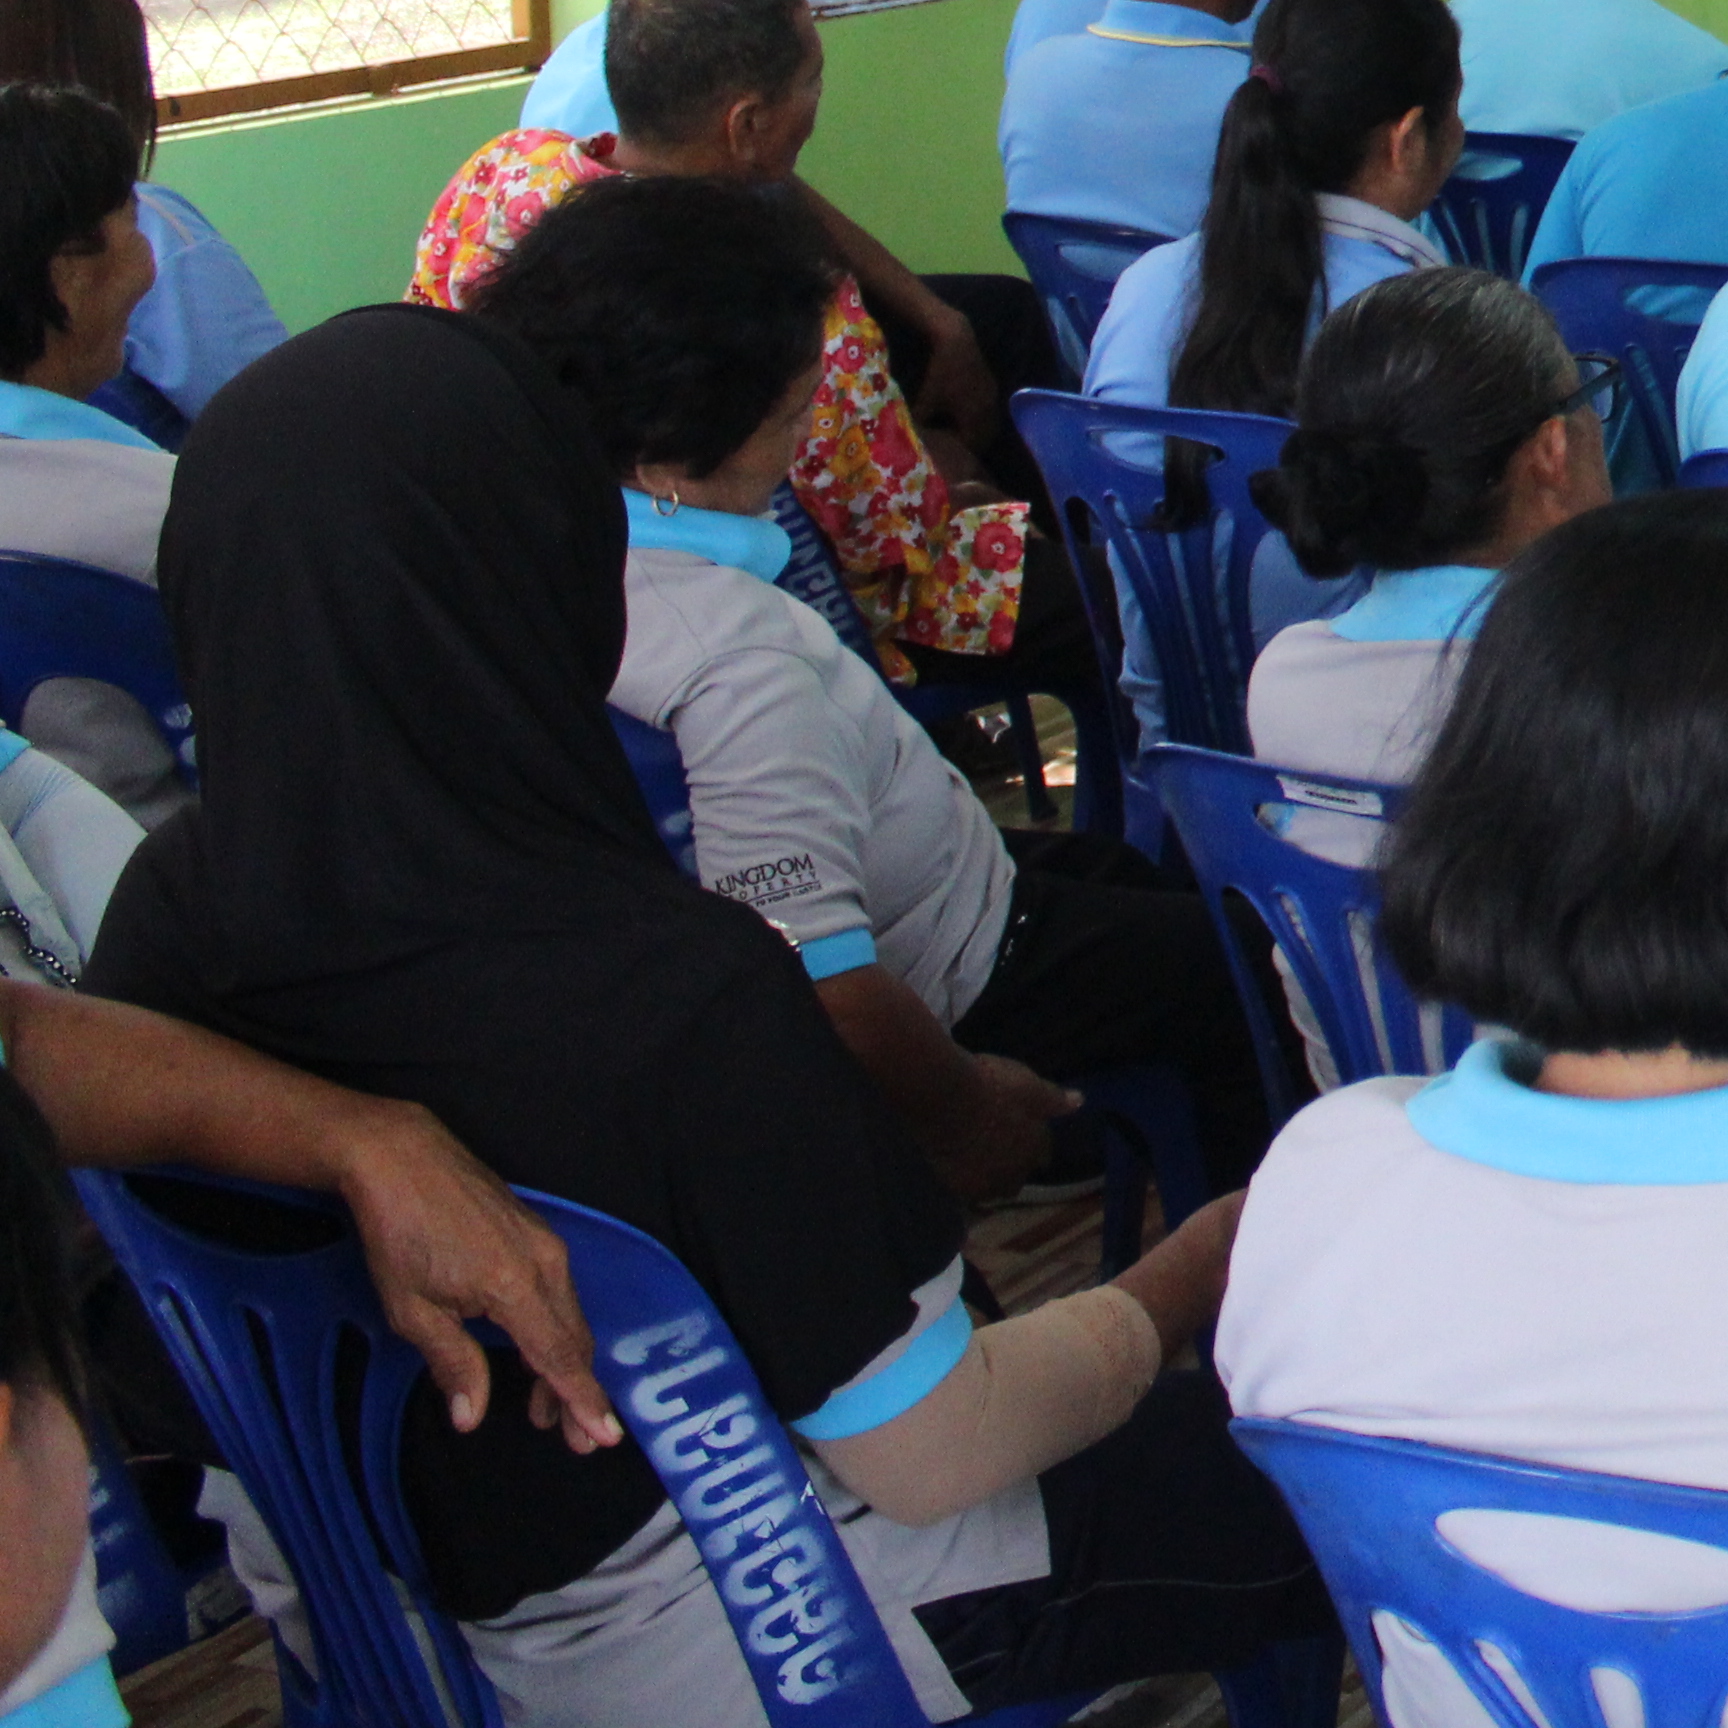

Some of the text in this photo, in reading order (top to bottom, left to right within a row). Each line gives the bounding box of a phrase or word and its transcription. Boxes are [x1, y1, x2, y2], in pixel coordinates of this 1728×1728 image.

[715, 853, 814, 894] KINGDOM
[740, 871, 816, 900] OPERTY
[611, 1309, 864, 1706] คลองกลาง
